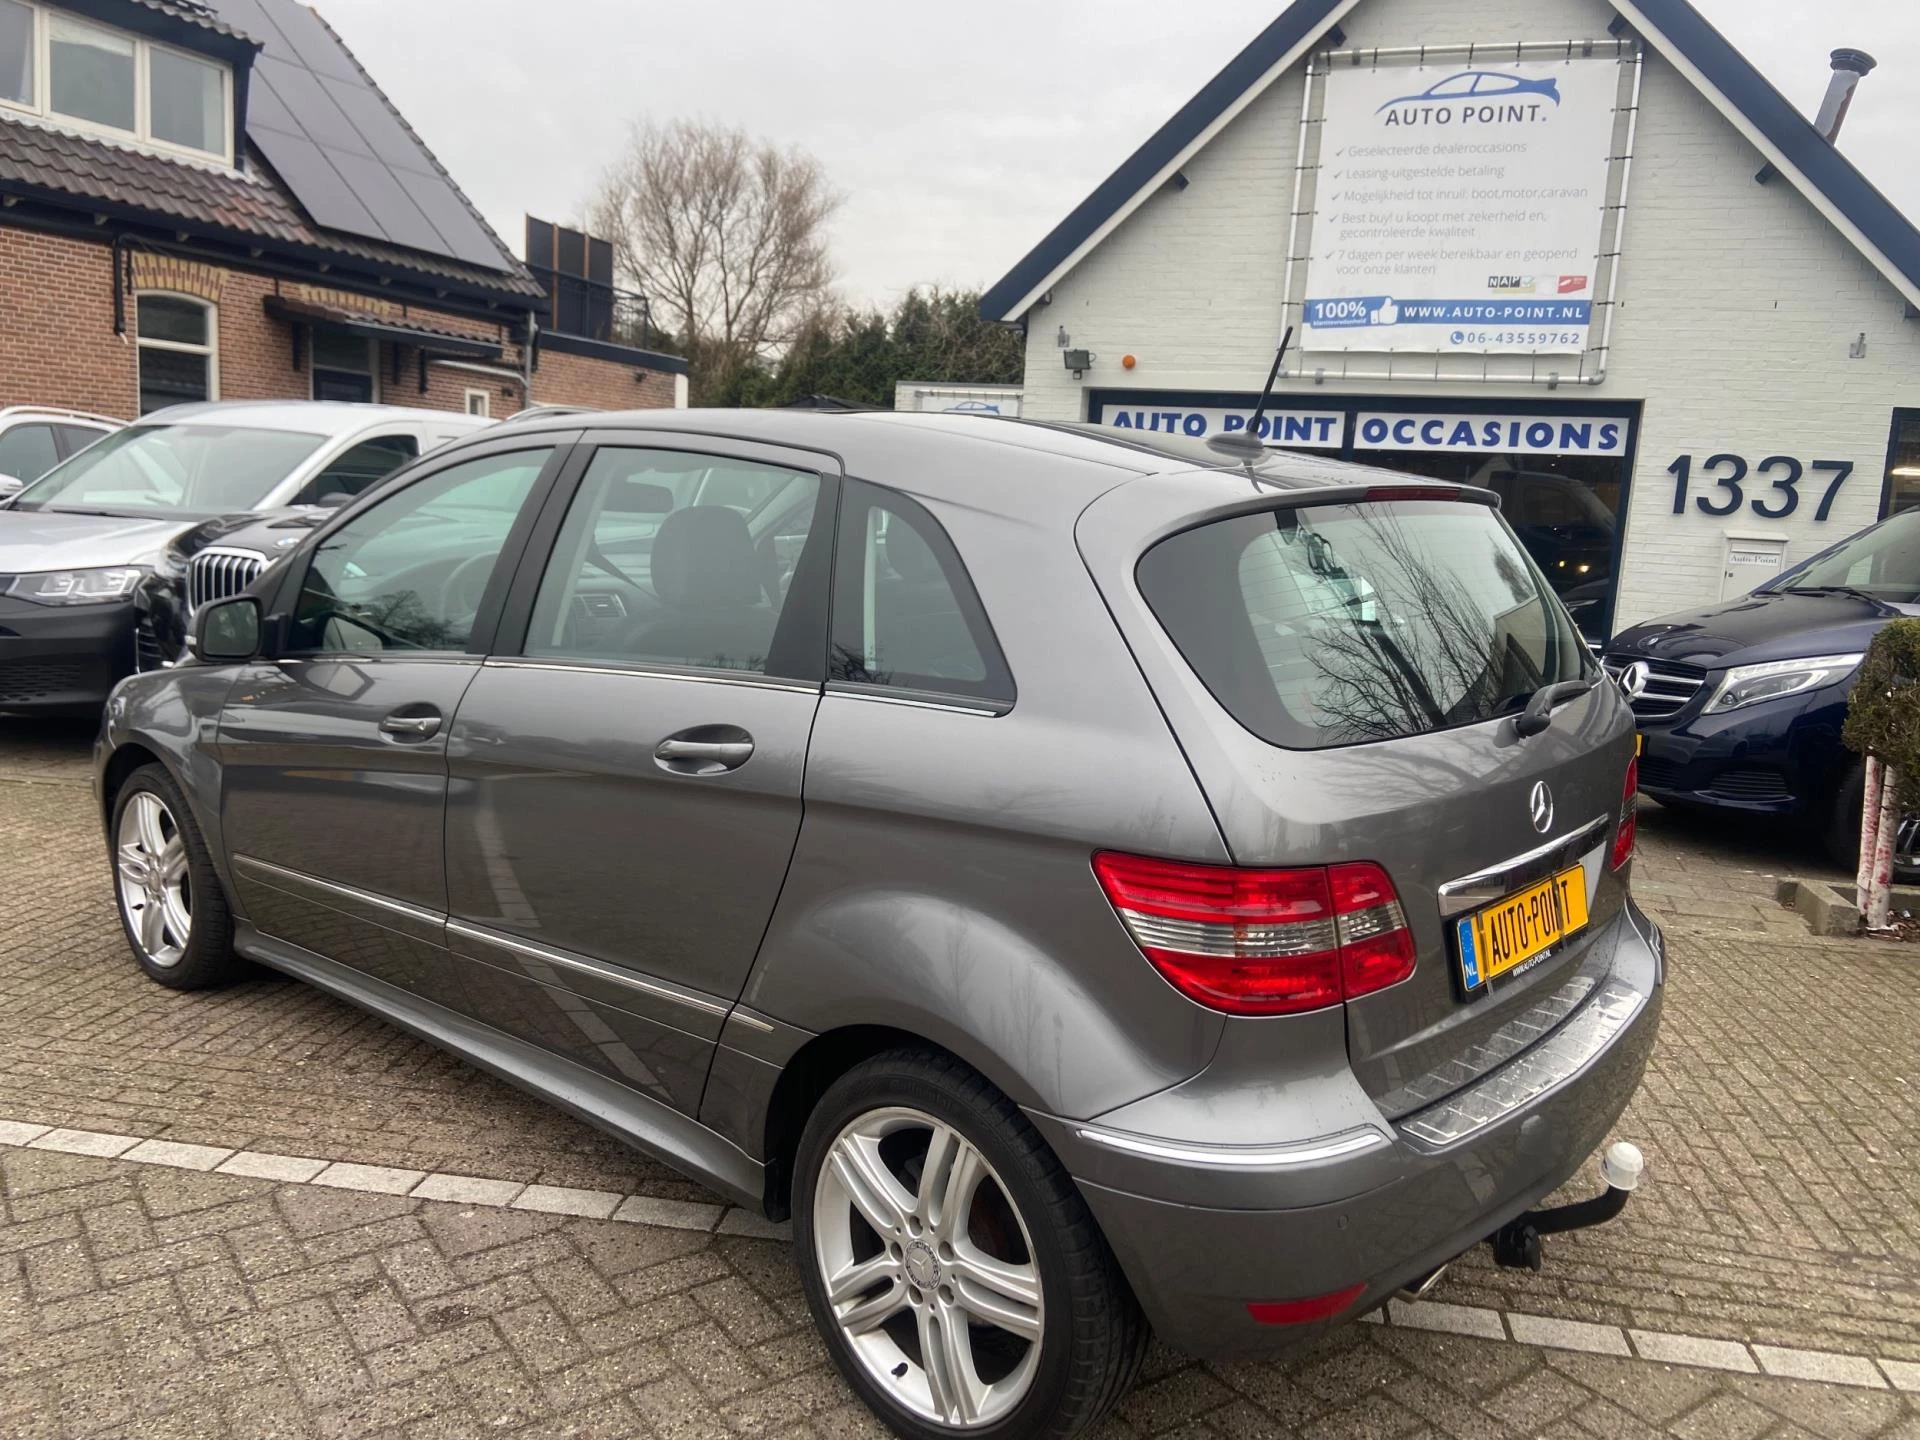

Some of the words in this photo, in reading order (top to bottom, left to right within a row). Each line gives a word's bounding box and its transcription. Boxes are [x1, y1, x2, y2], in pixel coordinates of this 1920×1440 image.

[1385, 107, 1451, 126] AUTO
[1348, 144, 1430, 157] Geselecteerde
[1432, 142, 1527, 155] dealeroccasions
[1346, 166, 1455, 180] Leasing-uitgestelde
[1458, 165, 1505, 179] betaling
[1344, 190, 1414, 204] Mogelijkheid
[1417, 190, 1433, 200] tot
[1342, 212, 1366, 224] Best
[1395, 215, 1403, 224] u
[1406, 212, 1439, 225] koopt
[1442, 212, 1464, 223] met
[1467, 210, 1526, 223] zekerheid
[1339, 227, 1426, 241] gecontroleerde
[1428, 227, 1475, 239] kwaliteit
[1338, 249, 1345, 261] 7
[1347, 249, 1382, 263] dagen
[1385, 251, 1404, 263] per
[1407, 248, 1438, 260] week
[1440, 248, 1503, 260] bereikbaar
[1505, 249, 1521, 260] en
[1523, 247, 1578, 262] geopend
[1336, 265, 1361, 275] voor
[1363, 265, 1391, 275] onze
[1394, 262, 1437, 275] klanten
[1488, 275, 1521, 288] NAP
[1315, 300, 1367, 319] 100%
[1404, 305, 1584, 320] WWW.AUTO-POINT.NL
[1467, 331, 1580, 345] 06-43559762
[1113, 411, 1207, 437] AUTO
[1224, 414, 1337, 442] POINT
[1362, 417, 1619, 451] OCCASIONS
[1667, 453, 1854, 522] 1337
[1465, 962, 1477, 978] NL
